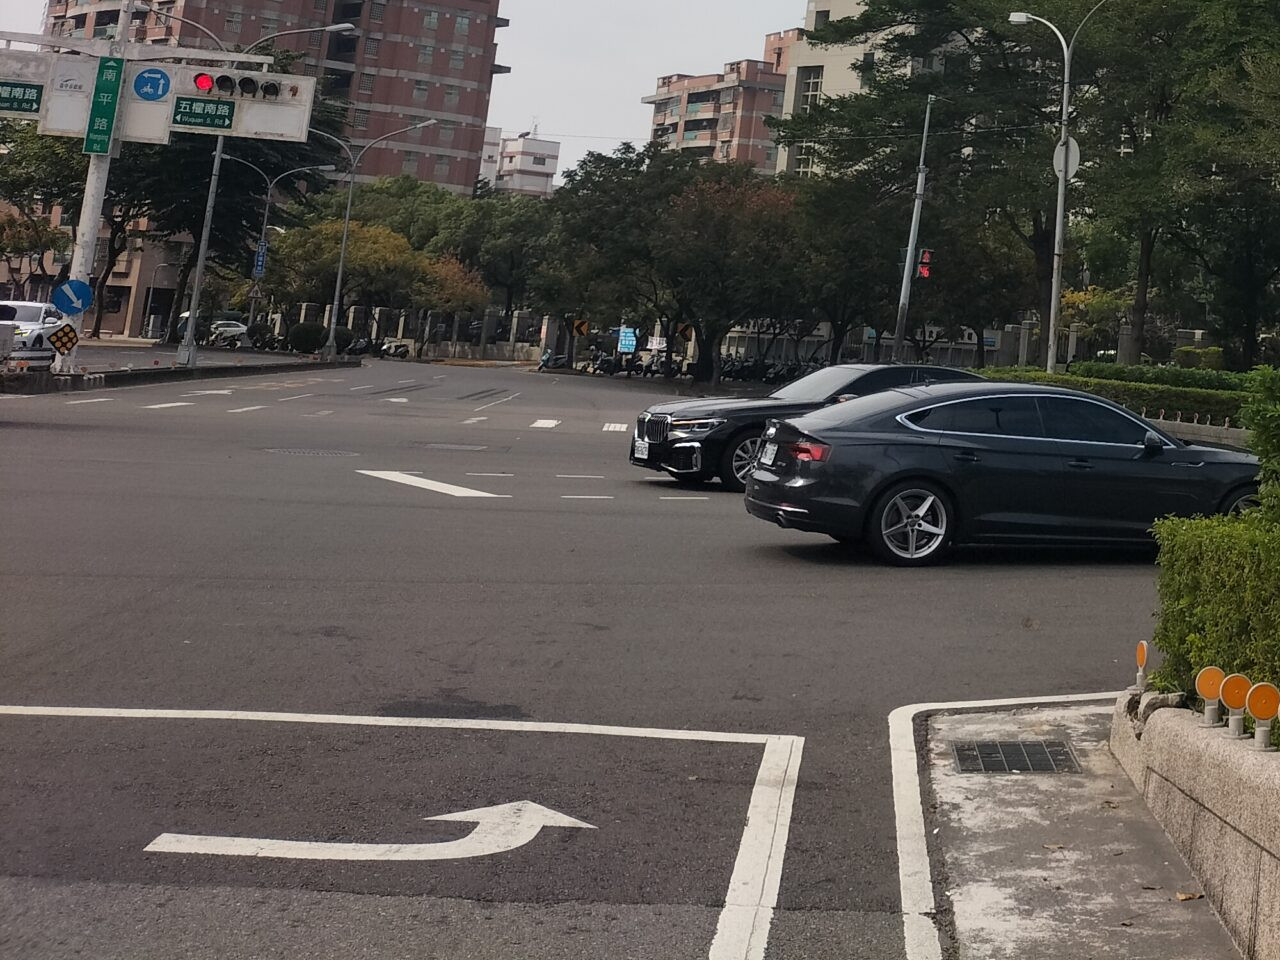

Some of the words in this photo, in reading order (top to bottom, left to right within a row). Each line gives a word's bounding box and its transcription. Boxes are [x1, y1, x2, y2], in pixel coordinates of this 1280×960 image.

[93, 69, 118, 131] 南平路
[177, 100, 230, 116] 五權南路
